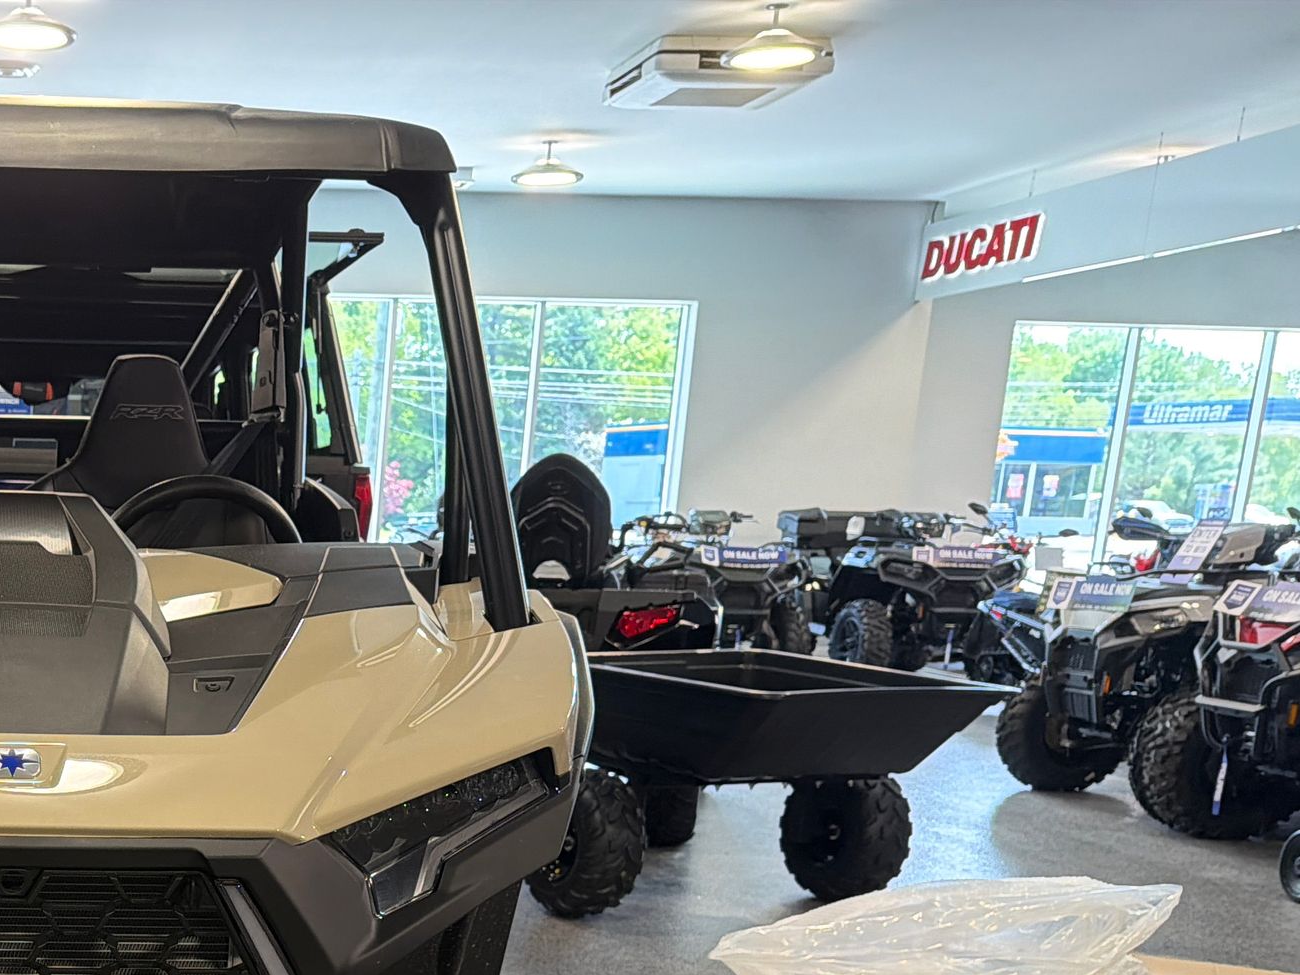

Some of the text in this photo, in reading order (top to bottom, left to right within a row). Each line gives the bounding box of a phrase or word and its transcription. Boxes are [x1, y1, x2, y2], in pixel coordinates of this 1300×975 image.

[921, 213, 1042, 280] DUCATI
[1143, 403, 1233, 424] Ultramar
[722, 550, 734, 558] ON
[736, 550, 757, 560] SALE
[758, 550, 780, 560] NOW
[939, 550, 952, 558] ON
[952, 550, 973, 559] SALE
[1080, 582, 1094, 594] ON
[1093, 582, 1116, 596] SALE
[1115, 583, 1133, 596] NOW
[1262, 589, 1280, 602] ON
